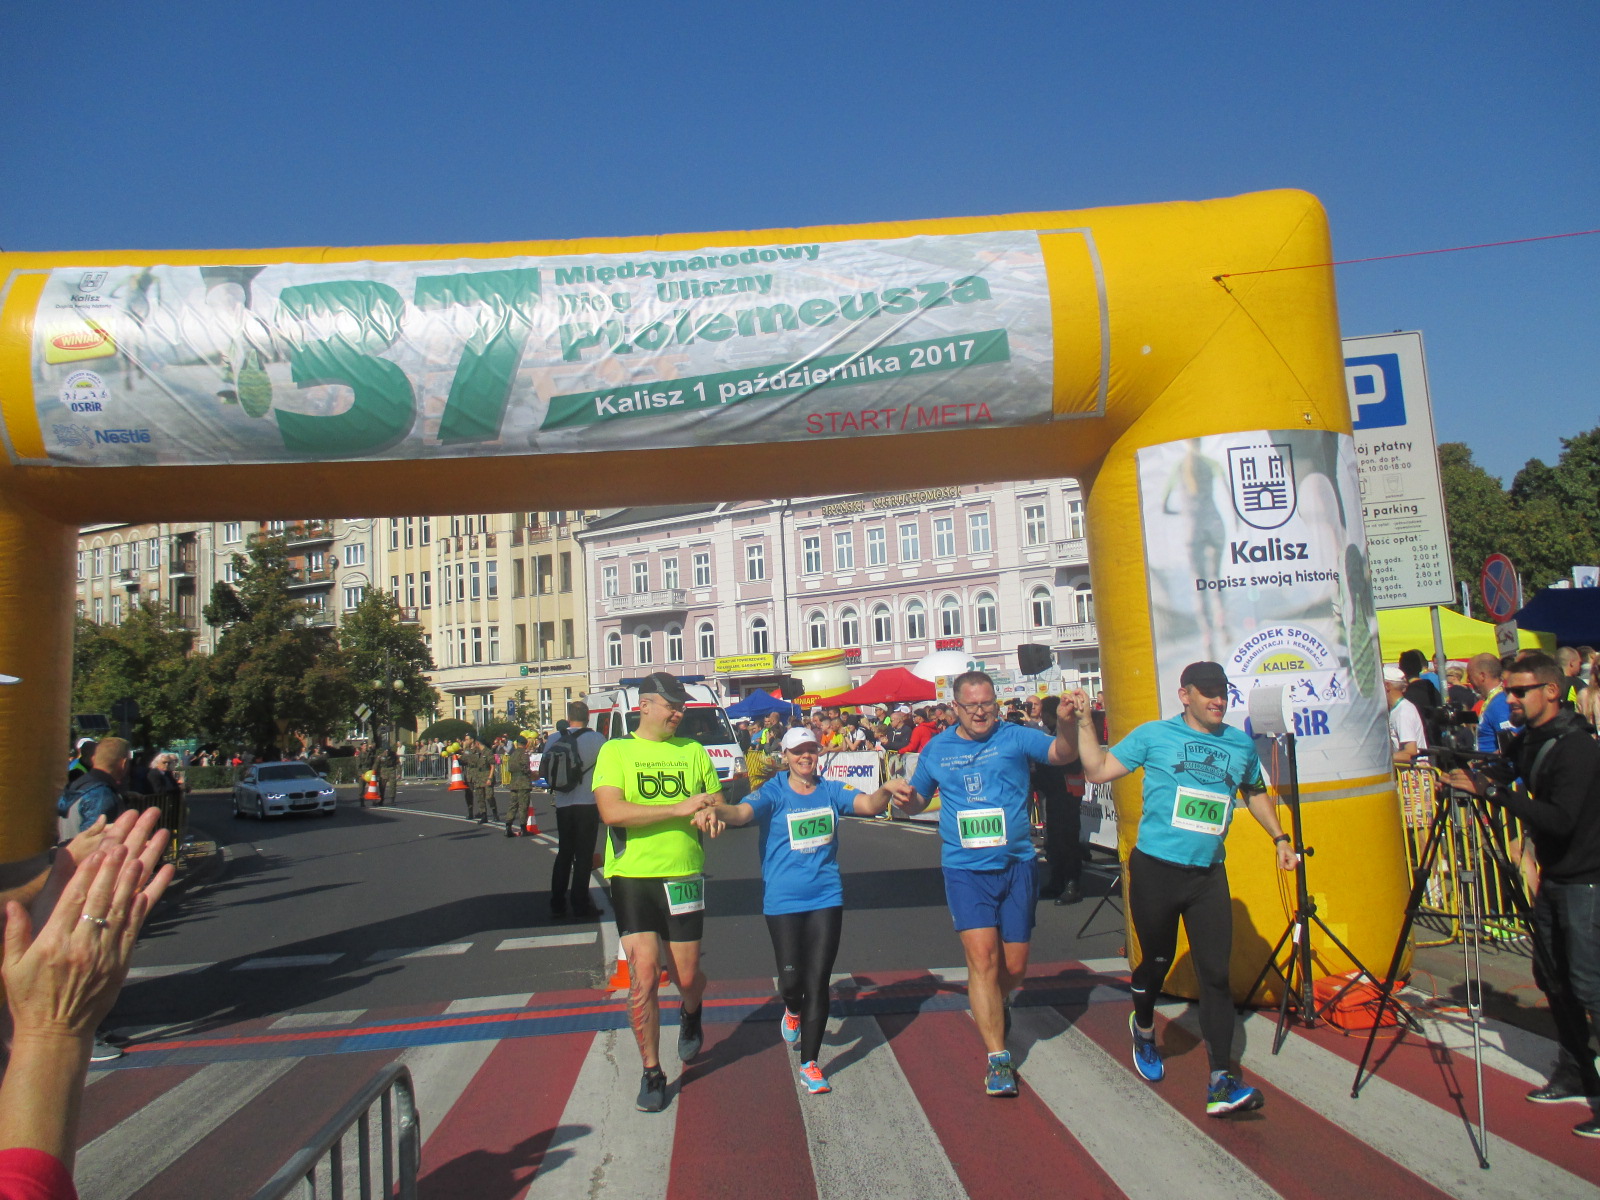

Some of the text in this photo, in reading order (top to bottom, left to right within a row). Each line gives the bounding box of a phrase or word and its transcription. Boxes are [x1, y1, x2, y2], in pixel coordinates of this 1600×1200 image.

[555, 245, 820, 286] Międzynarodowy
[657, 274, 773, 303] Uliczny
[595, 339, 975, 416] Kalisz 1 października 2017
[1345, 364, 1386, 422] P
[1373, 441, 1413, 455] płatny
[1373, 504, 1418, 518] parking
[1230, 538, 1309, 564] Kalisz
[1196, 568, 1340, 591] Dopisz swoją historię
[936, 638, 964, 649] ERGO
[1234, 628, 1328, 663] OŚRODEK SPORTU
[1241, 640, 1284, 673] REHABILITACJI
[1293, 641, 1324, 667] REKREACJI
[1263, 660, 1305, 672] KALISZ
[1188, 745, 1228, 761] BIEGAM
[827, 764, 874, 777] INTERSPORT
[637, 770, 691, 799] bbl
[1185, 800, 1219, 821] 676
[798, 818, 828, 837] 675
[961, 818, 1002, 836] 1000
[675, 882, 700, 901] 703
